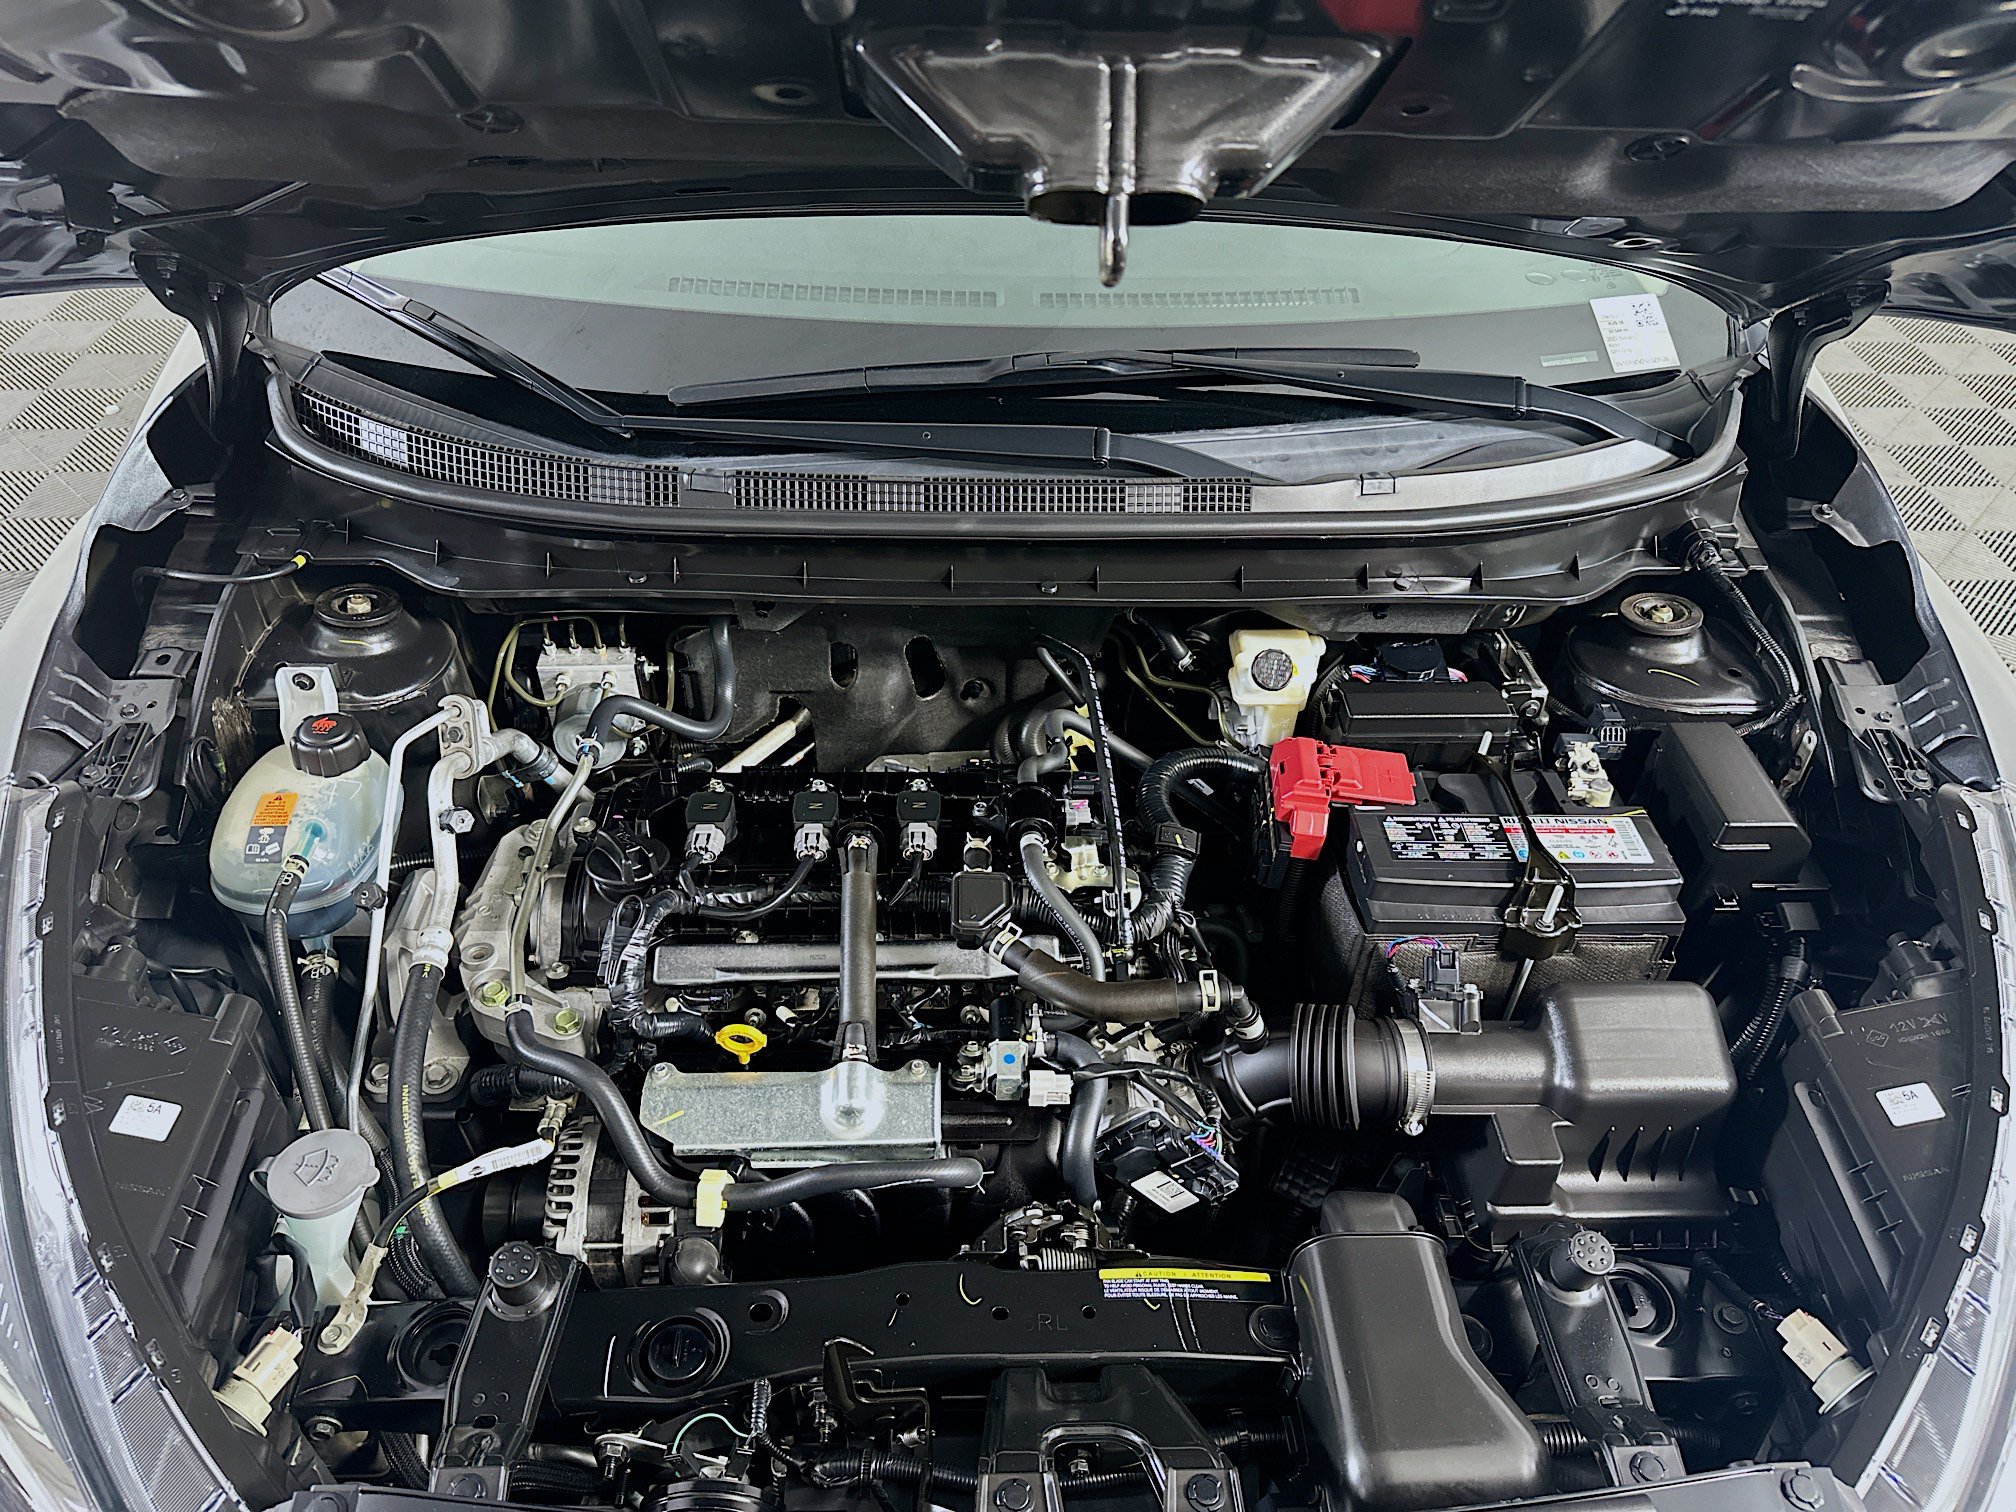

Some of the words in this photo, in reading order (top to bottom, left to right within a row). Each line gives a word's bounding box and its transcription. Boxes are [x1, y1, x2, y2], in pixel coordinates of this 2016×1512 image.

[1554, 817, 1608, 825] NISSAN
[1889, 1018, 1917, 1033] 12V
[1903, 1089, 1919, 1101] 5A
[146, 1103, 163, 1115] 5A
